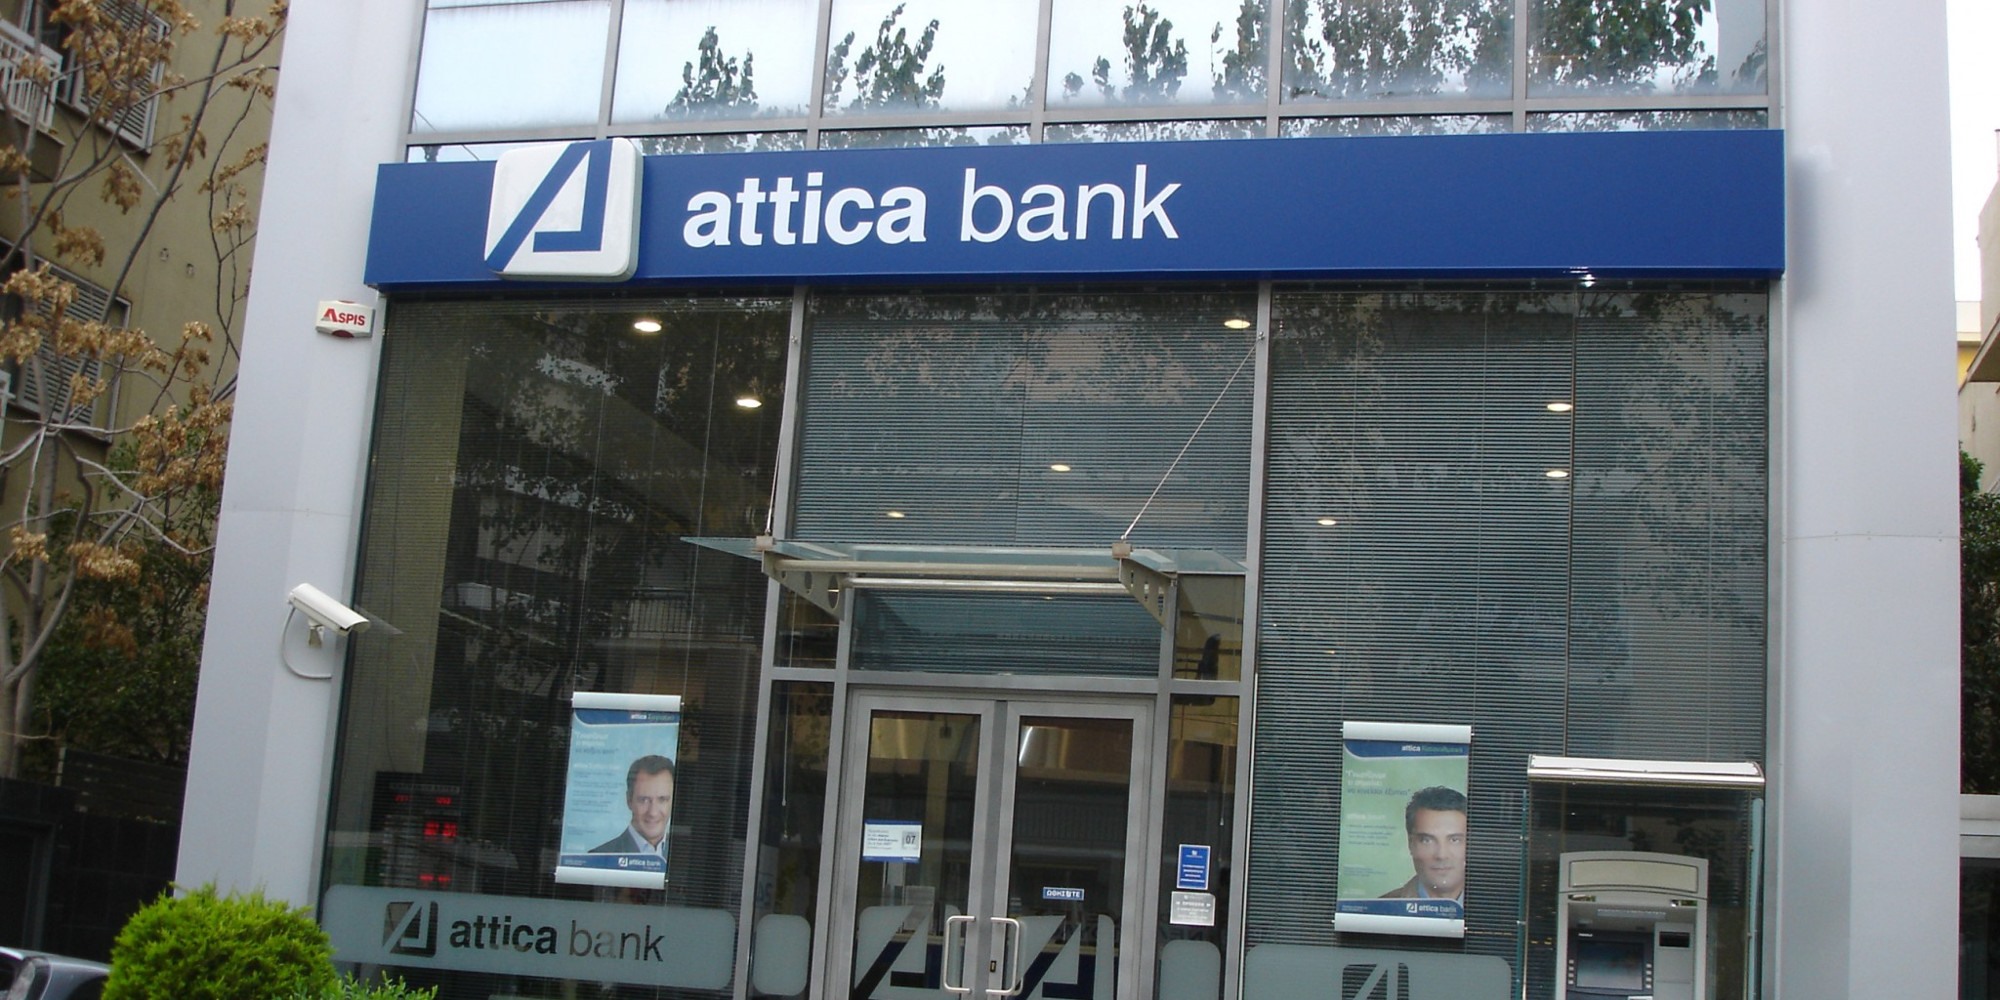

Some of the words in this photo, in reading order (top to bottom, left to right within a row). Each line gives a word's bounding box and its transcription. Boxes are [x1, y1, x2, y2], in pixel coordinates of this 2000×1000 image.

[683, 172, 927, 248] attica
[960, 164, 1182, 243] bank
[321, 308, 366, 326] ASPIS
[1401, 744, 1421, 752] attica
[905, 834, 917, 845] 07
[628, 858, 646, 866] attica
[1418, 904, 1439, 912] attica
[450, 915, 557, 954] attica
[569, 920, 665, 962] bank
